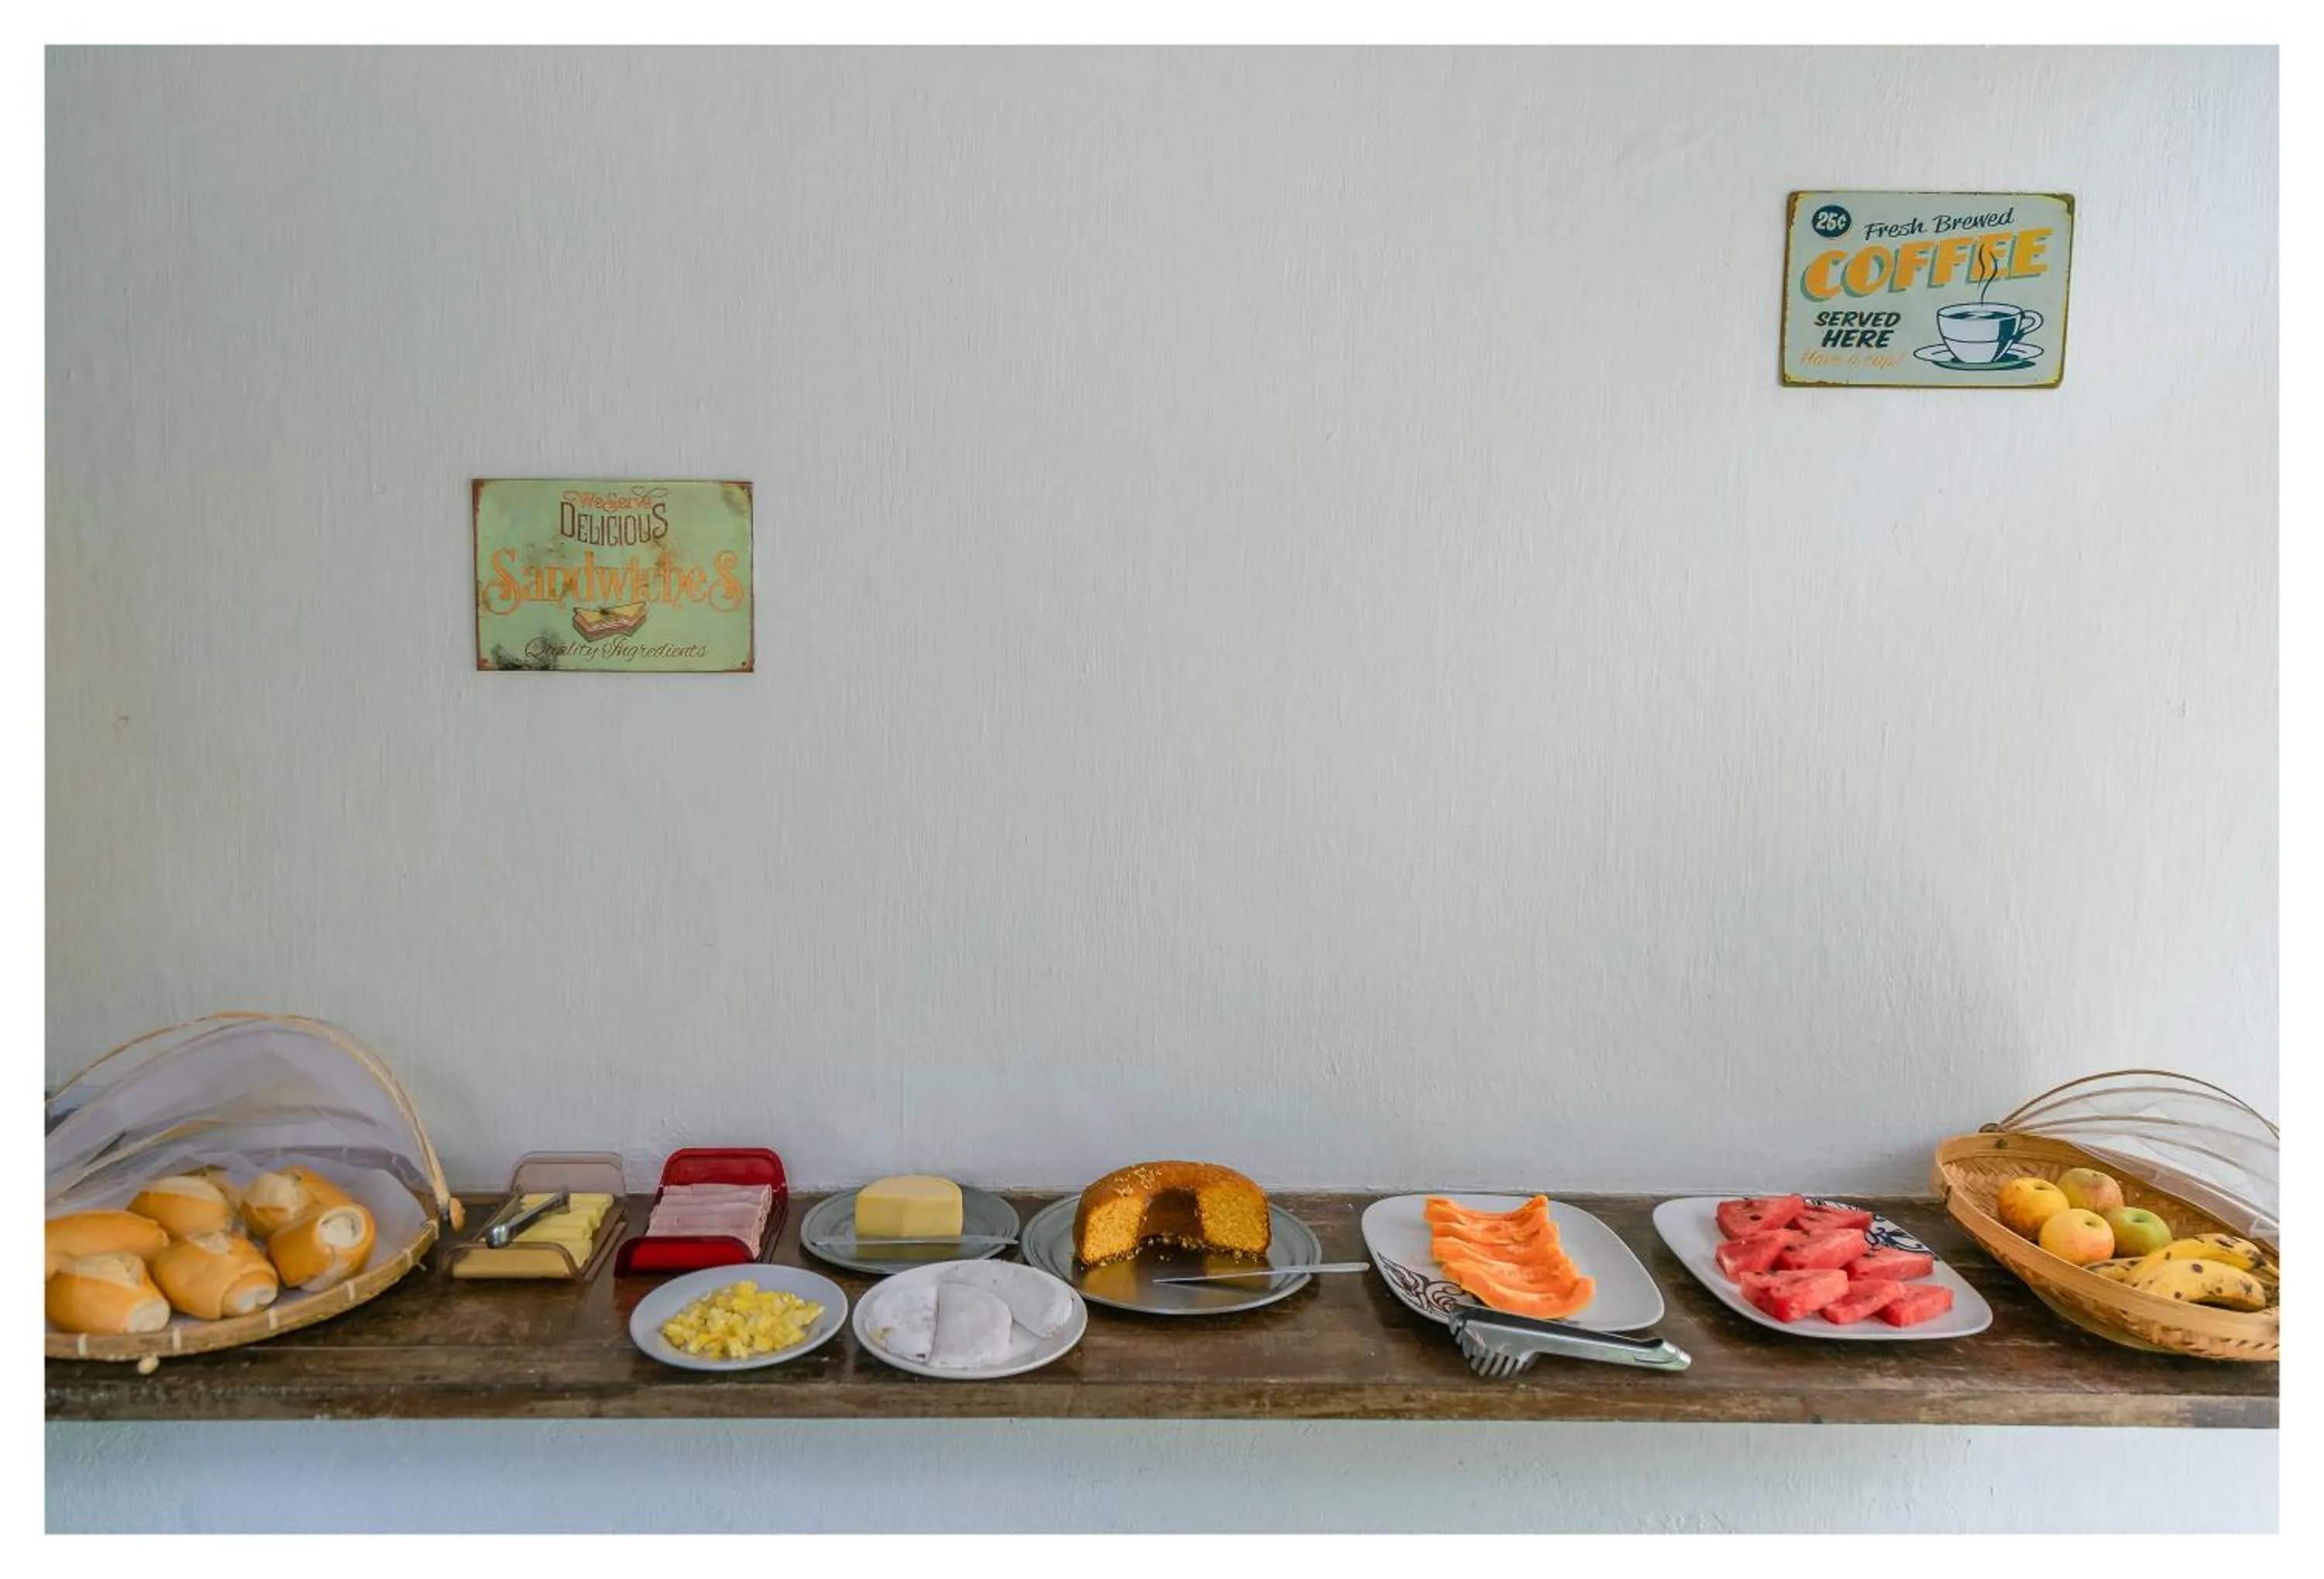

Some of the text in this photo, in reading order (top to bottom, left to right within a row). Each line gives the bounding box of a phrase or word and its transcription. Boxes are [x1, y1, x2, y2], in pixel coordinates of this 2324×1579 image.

[1863, 207, 2015, 241] Fresh Brewed
[1800, 228, 2054, 302] COFFEE
[1814, 311, 1901, 327] SERVED
[1821, 329, 1894, 348] HERE
[1801, 350, 1844, 367] Have
[559, 502, 669, 546] DELICIOUS
[524, 636, 707, 662] Quality Ingredients
